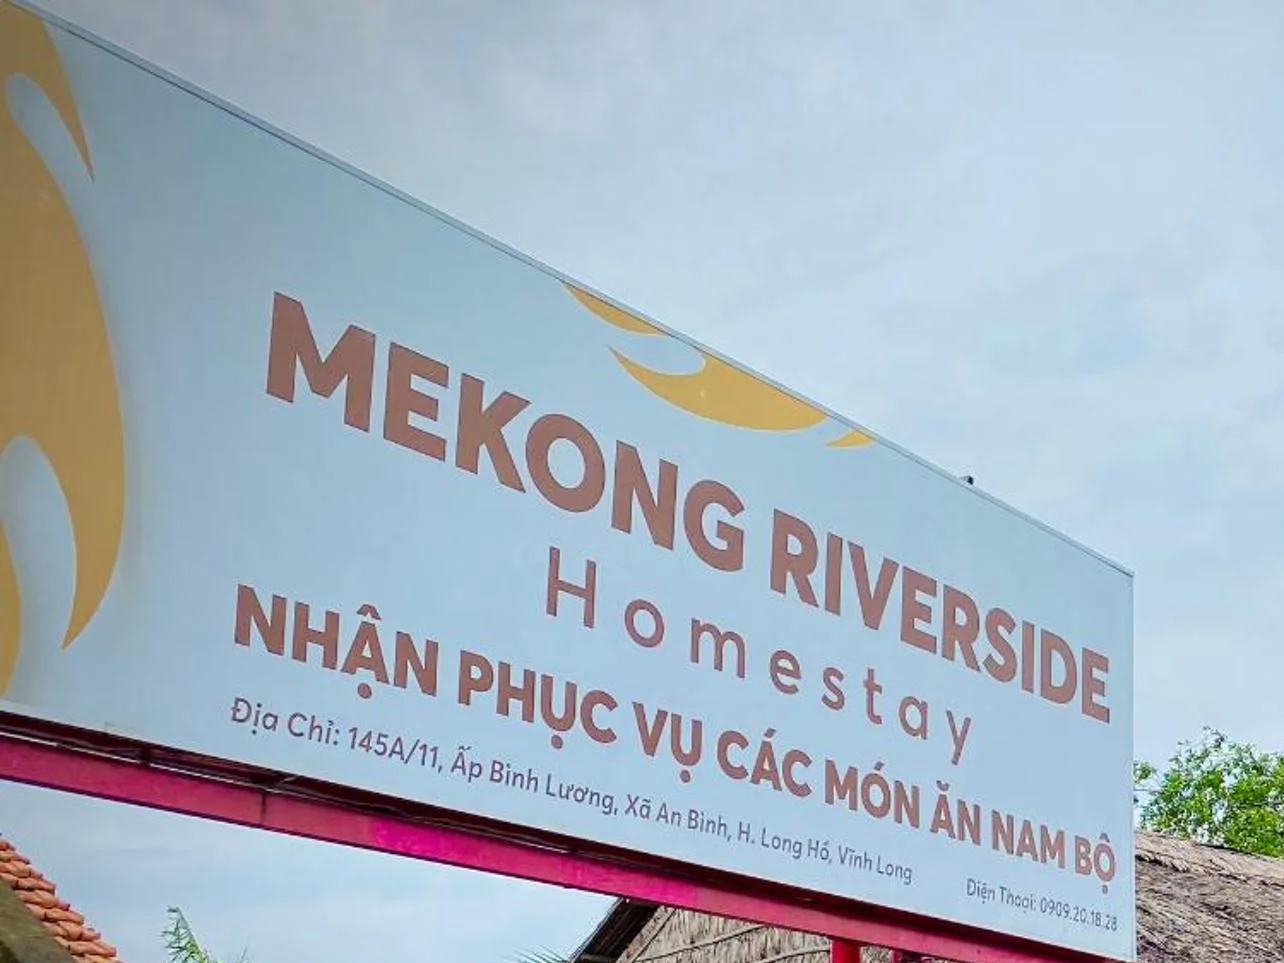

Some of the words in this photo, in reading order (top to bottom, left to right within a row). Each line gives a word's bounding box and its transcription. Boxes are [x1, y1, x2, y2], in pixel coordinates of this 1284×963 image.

[266, 290, 745, 573] MEKONG
[769, 507, 1110, 724] RIVERSIDE
[233, 583, 440, 701] NHẬN
[457, 650, 619, 750] PHỤC
[631, 700, 703, 784] VỤ
[716, 728, 813, 798] CÁC
[824, 760, 921, 830] MÓN
[929, 779, 982, 847] ĂN
[991, 809, 1066, 869] NAM
[1074, 832, 1117, 895] BỘ
[545, 545, 972, 766] Homestay
[231, 697, 279, 736] Địa
[348, 727, 444, 774] 145A/11,
[450, 745, 483, 784] Ấp
[545, 773, 619, 817] Lương,
[624, 793, 653, 822] Xã
[655, 801, 683, 829] An
[736, 820, 757, 846] H.
[760, 828, 803, 860] Long
[838, 844, 873, 872] Vĩnh
[876, 855, 914, 886] Long
[999, 886, 1037, 914] Thoại:
